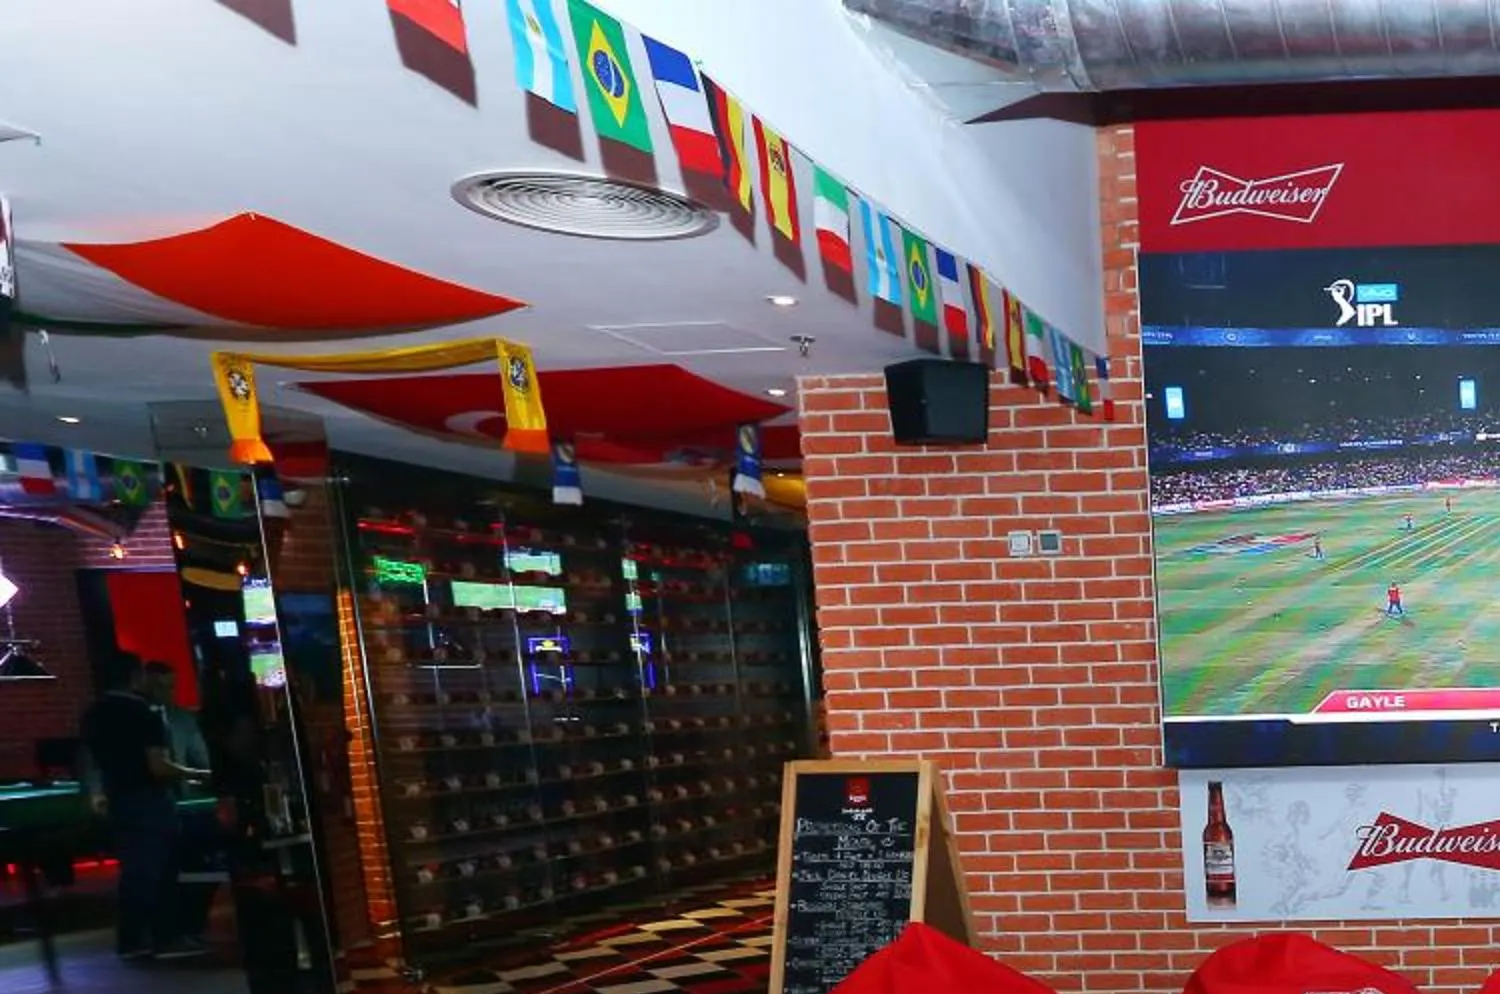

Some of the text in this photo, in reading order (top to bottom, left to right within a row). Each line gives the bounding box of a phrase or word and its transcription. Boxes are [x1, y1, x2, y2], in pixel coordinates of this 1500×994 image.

[1179, 179, 1330, 209] Budweiser
[1357, 303, 1399, 327] IPL
[1346, 695, 1405, 709] GAYLE
